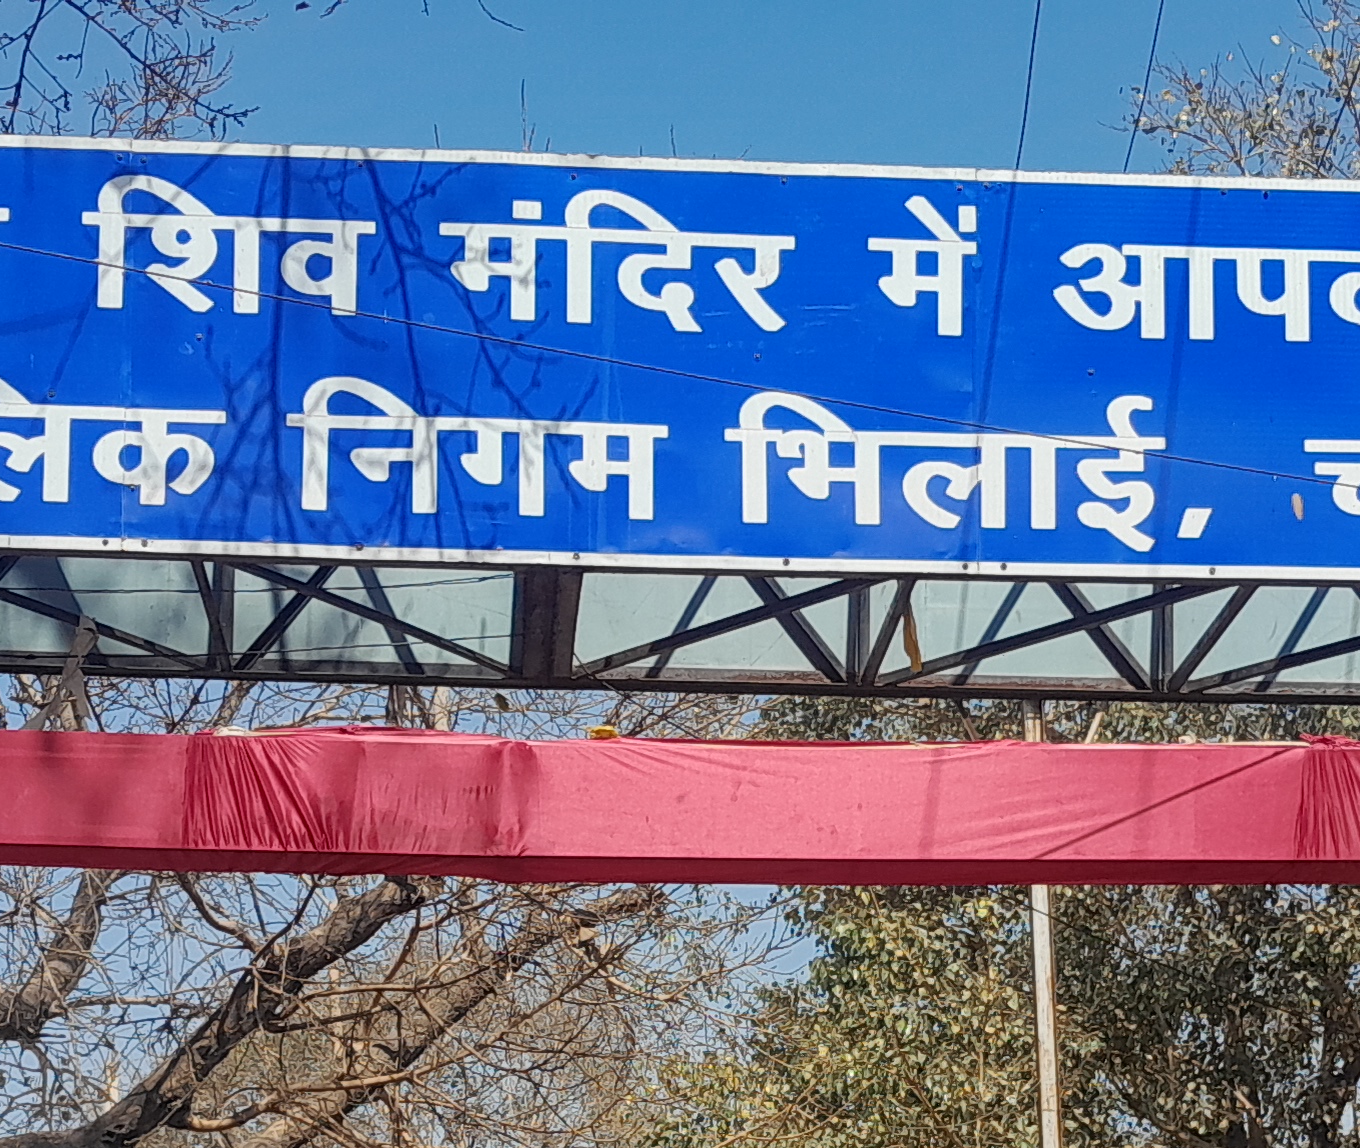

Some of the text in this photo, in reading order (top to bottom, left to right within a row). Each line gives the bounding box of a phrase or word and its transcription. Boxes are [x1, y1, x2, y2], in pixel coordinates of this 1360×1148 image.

[82, 175, 376, 315] शिव
[439, 190, 795, 332] मंदिर
[868, 196, 977, 336] में
[286, 376, 669, 521] निगम
[724, 394, 1212, 552] भिलाई,
